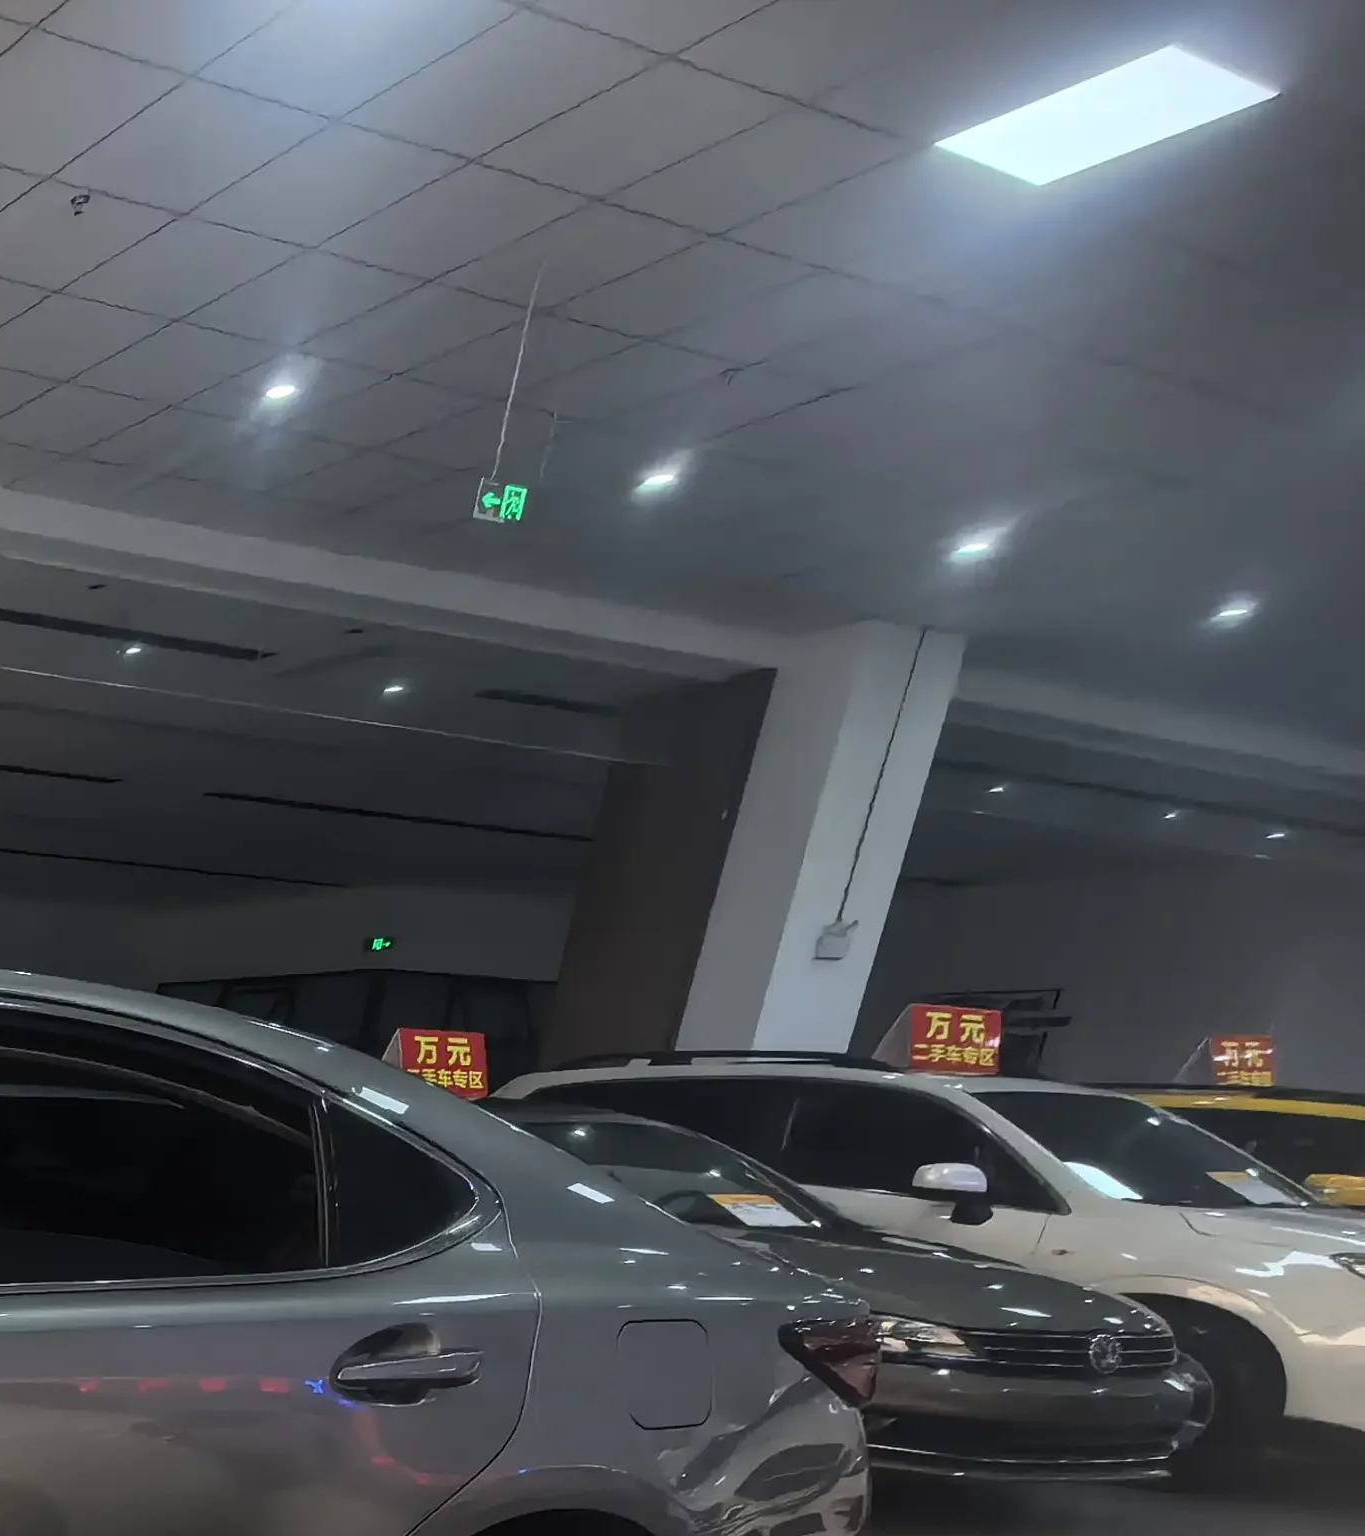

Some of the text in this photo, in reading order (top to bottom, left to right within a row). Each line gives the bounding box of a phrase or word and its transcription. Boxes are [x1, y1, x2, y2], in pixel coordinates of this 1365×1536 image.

[926, 1011, 985, 1044] 万元
[414, 1035, 472, 1066] 万元
[912, 1043, 997, 1067] 二手车专区
